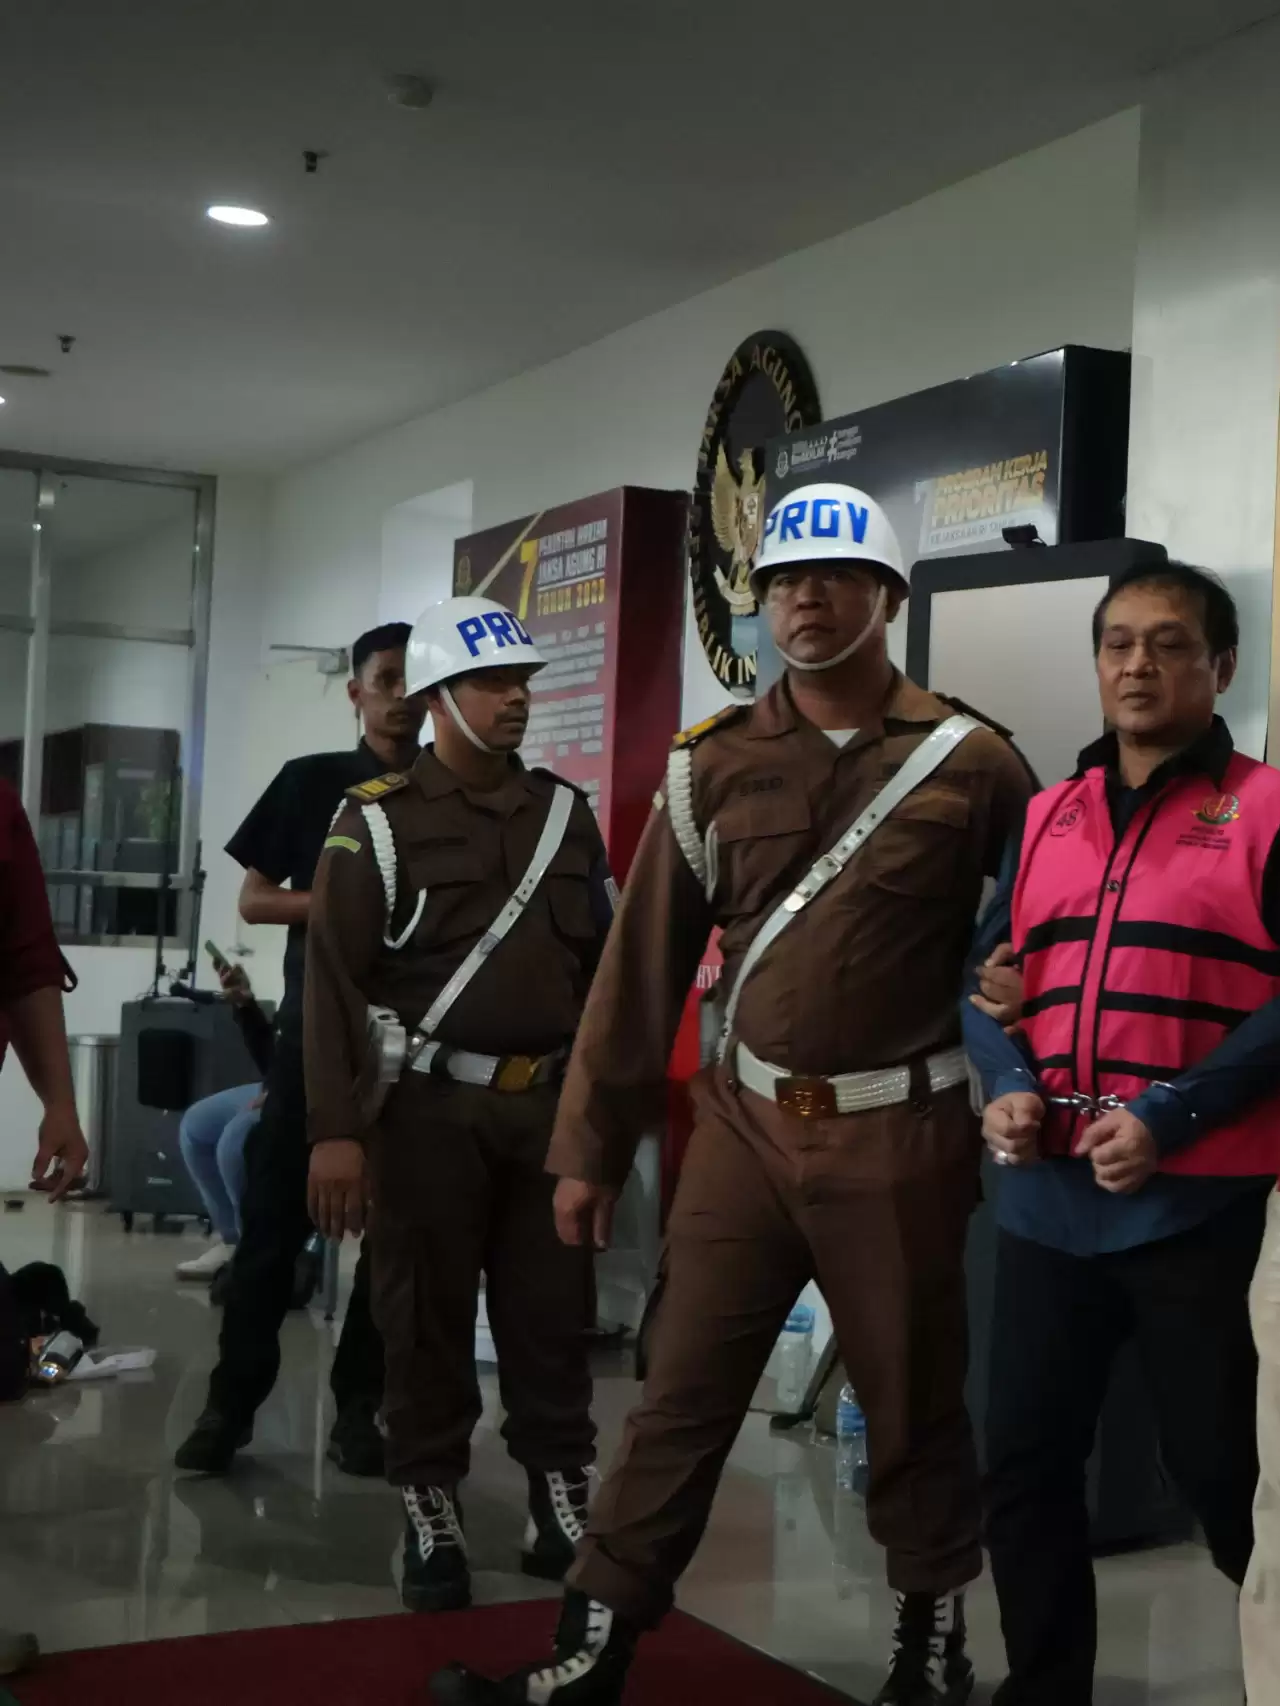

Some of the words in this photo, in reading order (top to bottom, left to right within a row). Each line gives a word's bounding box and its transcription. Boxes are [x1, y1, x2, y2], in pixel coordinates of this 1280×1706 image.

[748, 344, 803, 435] AGUNG
[764, 499, 868, 544] PROV
[931, 471, 1045, 527] PRIORITAS
[518, 538, 540, 621] 7
[565, 546, 596, 578] AGUNG
[537, 586, 572, 617] TAHUN
